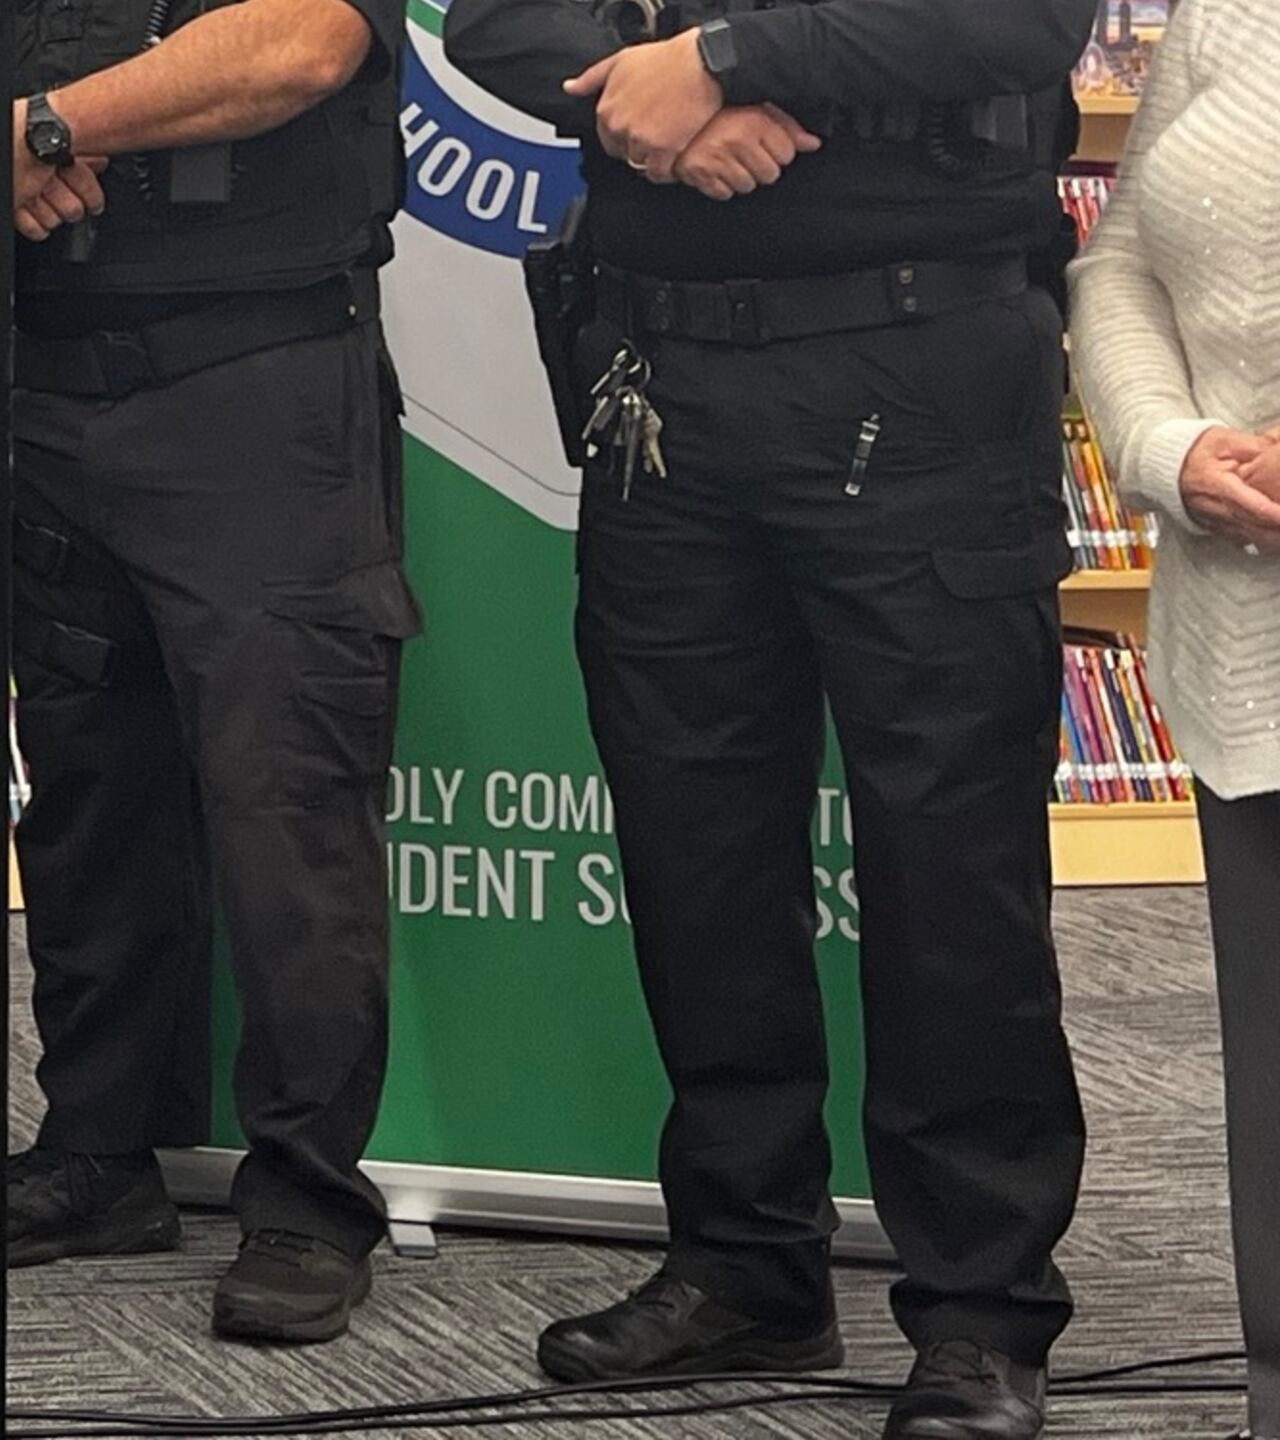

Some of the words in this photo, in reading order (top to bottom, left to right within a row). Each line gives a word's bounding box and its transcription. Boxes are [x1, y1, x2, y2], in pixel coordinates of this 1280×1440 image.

[399, 102, 547, 233] HOOL
[485, 770, 614, 833] COM
[386, 842, 555, 921] DENT
